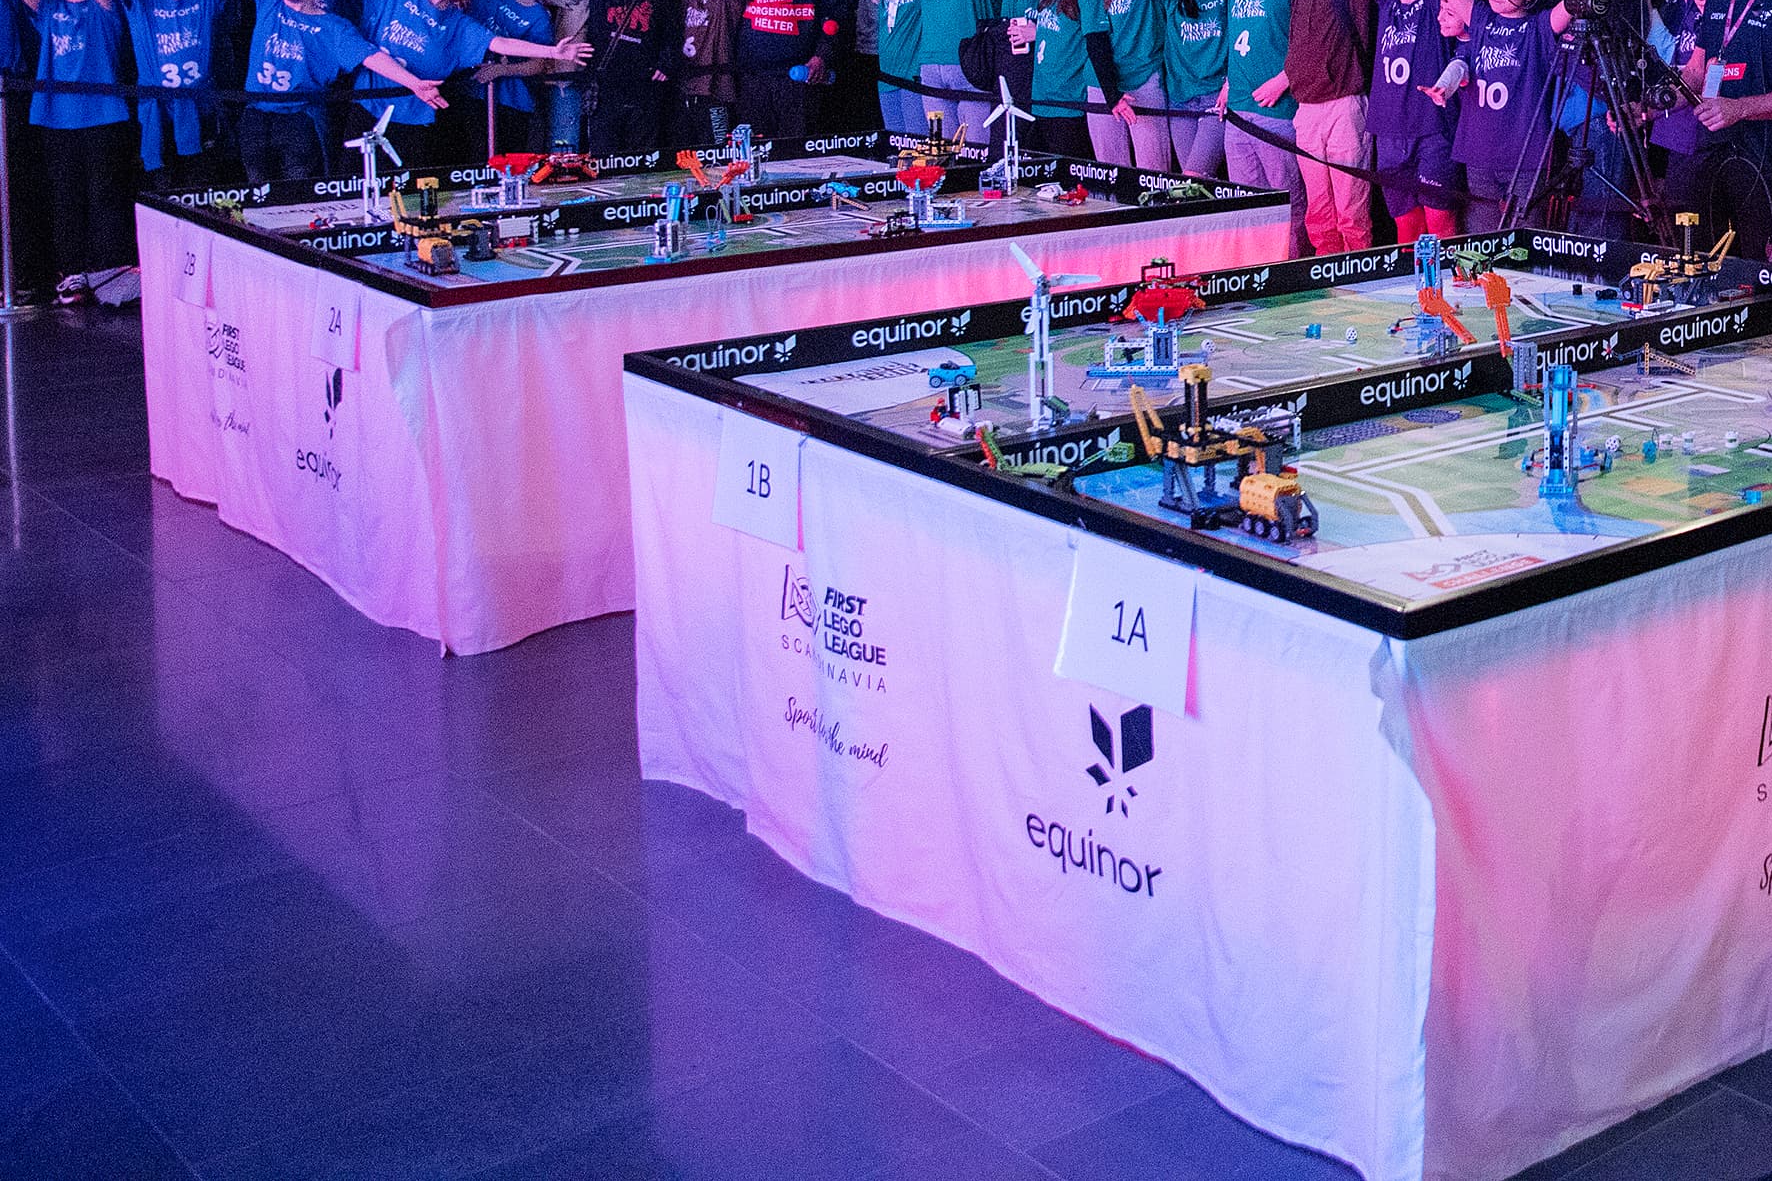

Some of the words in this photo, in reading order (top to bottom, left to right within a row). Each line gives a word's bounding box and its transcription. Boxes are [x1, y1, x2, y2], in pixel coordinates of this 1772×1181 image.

[755, 17, 793, 31] HELTER
[683, 36, 698, 57] 6
[1234, 30, 1251, 57] 4
[161, 61, 202, 89] 33
[257, 57, 294, 91] 33
[1382, 56, 1411, 85] 10
[1476, 78, 1509, 110] 10
[805, 135, 864, 154] equinor
[588, 154, 643, 174] quinor
[1070, 162, 1108, 181] equinor
[1532, 235, 1591, 257] equinor
[184, 251, 196, 276] 2B
[1310, 255, 1381, 282] equinor
[329, 306, 342, 336] 2A
[852, 317, 948, 349] equinor
[1660, 314, 1731, 347] equinor
[1537, 340, 1598, 369] quinor
[1360, 370, 1450, 407] equinor
[746, 459, 771, 499] 1B
[824, 586, 868, 616] FIRST
[824, 608, 864, 638] LEGO
[1111, 599, 1148, 652] 1A
[824, 632, 887, 665] LEAGUE
[849, 742, 890, 768] mind
[1026, 813, 1163, 897] equinor
